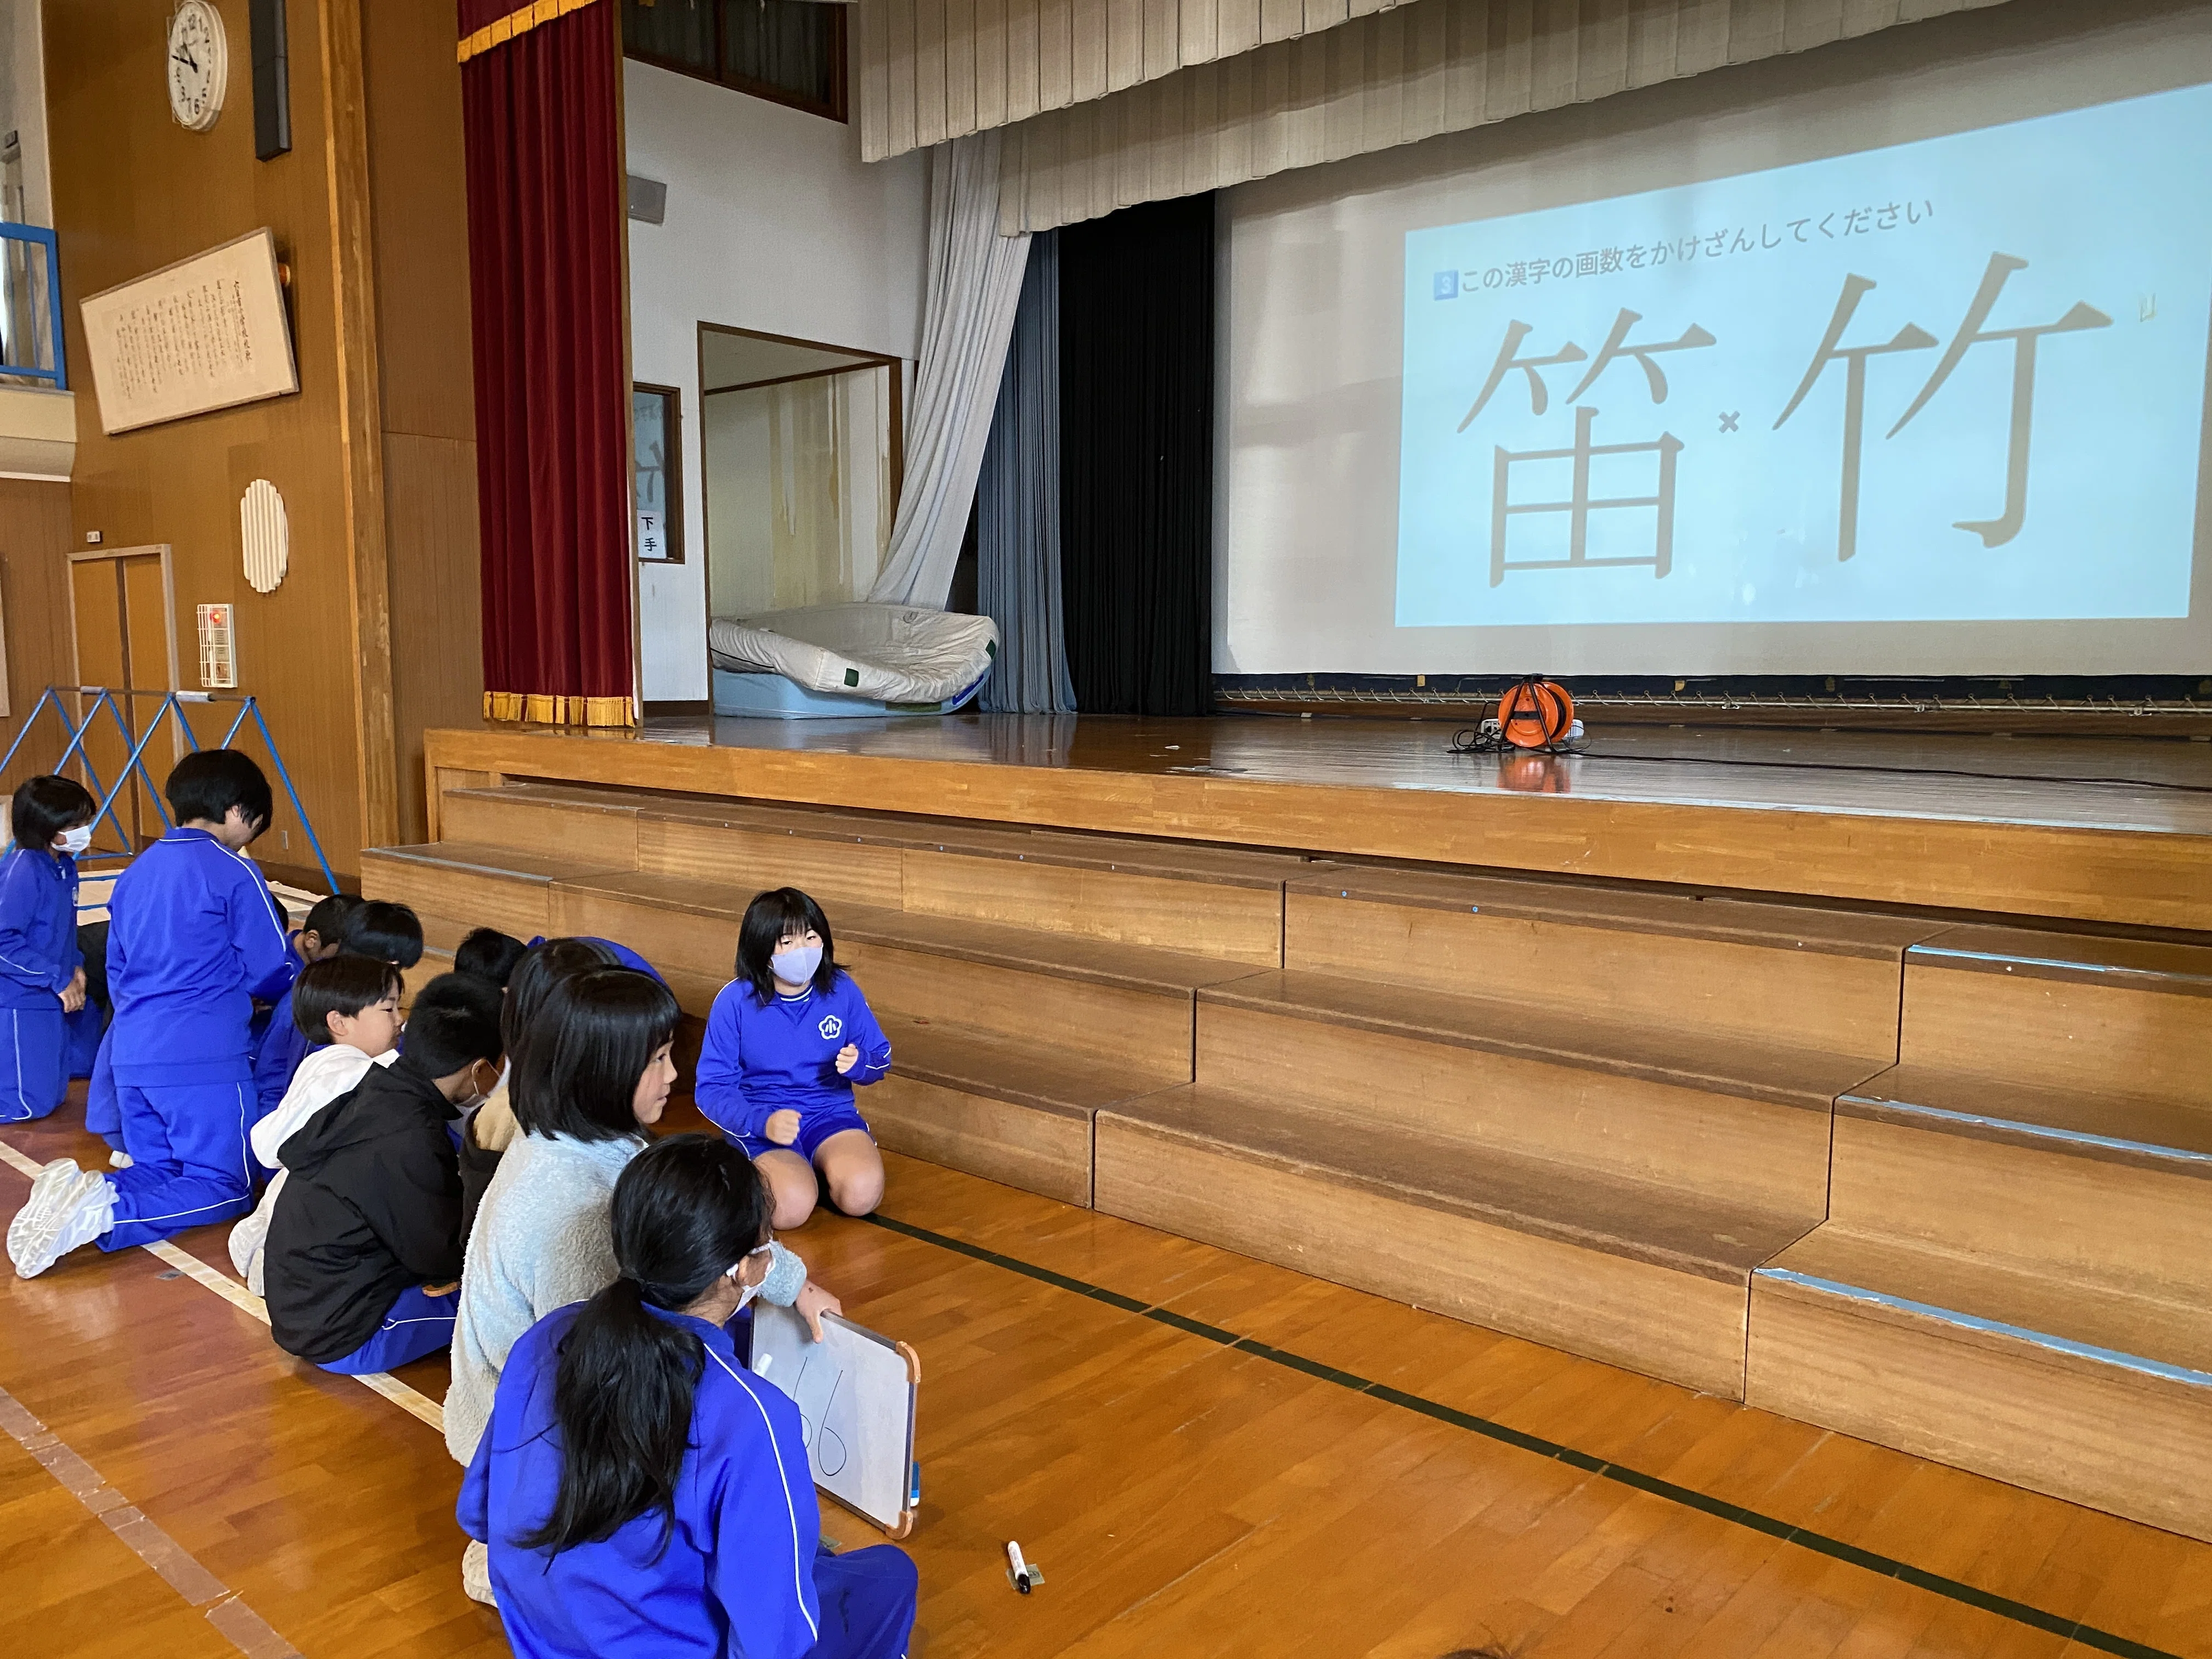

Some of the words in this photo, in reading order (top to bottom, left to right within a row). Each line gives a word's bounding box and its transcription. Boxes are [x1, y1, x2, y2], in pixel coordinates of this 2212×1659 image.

[1462, 199, 1934, 292] この漢字の画数をかけざんしてください
[1457, 307, 1717, 588] 笛
[1771, 251, 2114, 562] 竹
[641, 517, 657, 552] 下手
